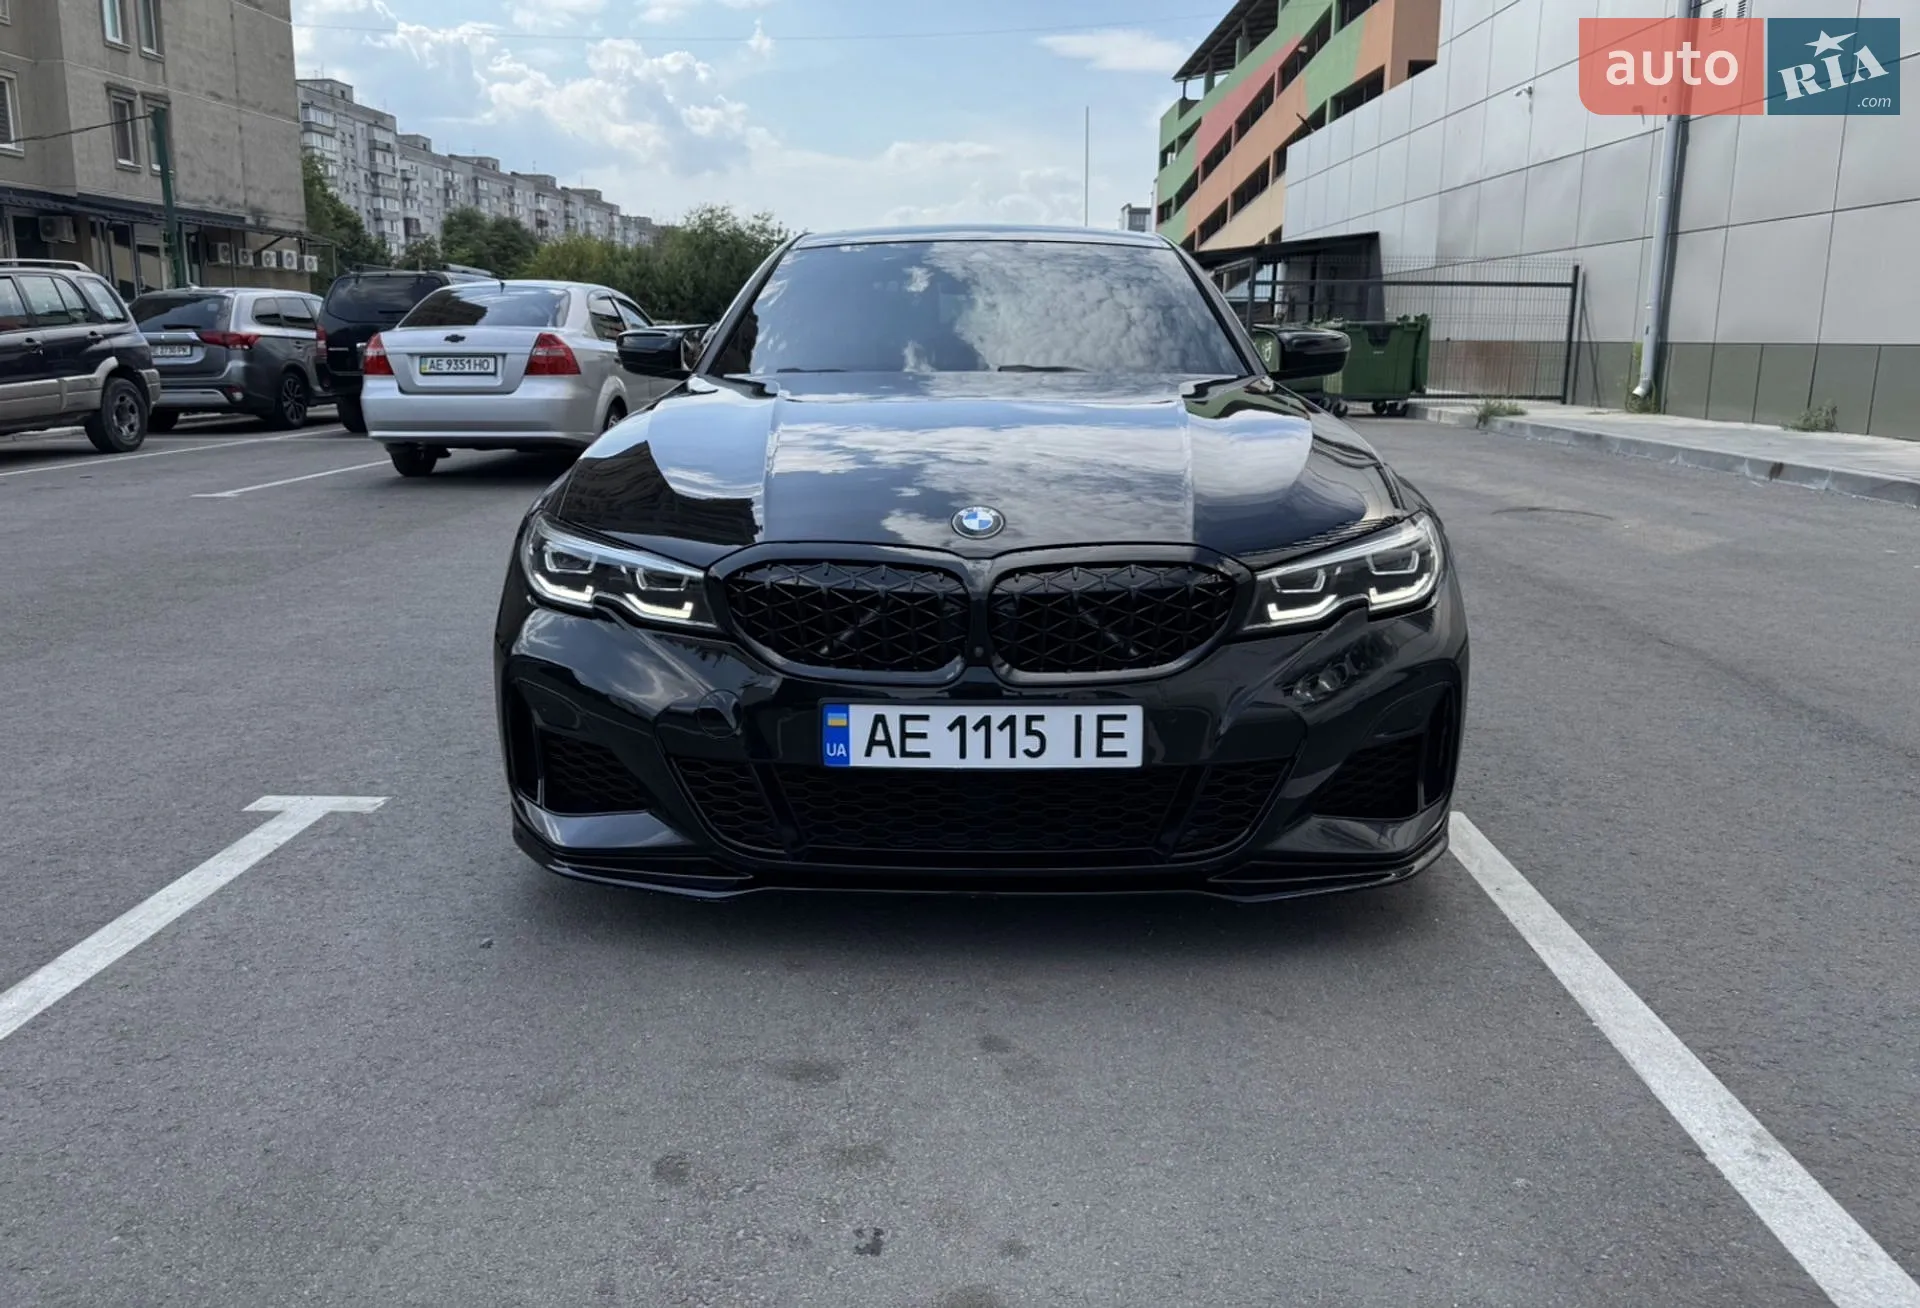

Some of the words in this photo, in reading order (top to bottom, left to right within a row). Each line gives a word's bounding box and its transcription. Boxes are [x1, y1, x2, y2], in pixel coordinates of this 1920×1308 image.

[428, 358, 444, 371] AE
[864, 713, 931, 758] AE
[946, 714, 1047, 759] 1115
[1073, 713, 1128, 758] IE
[826, 742, 847, 757] UA
